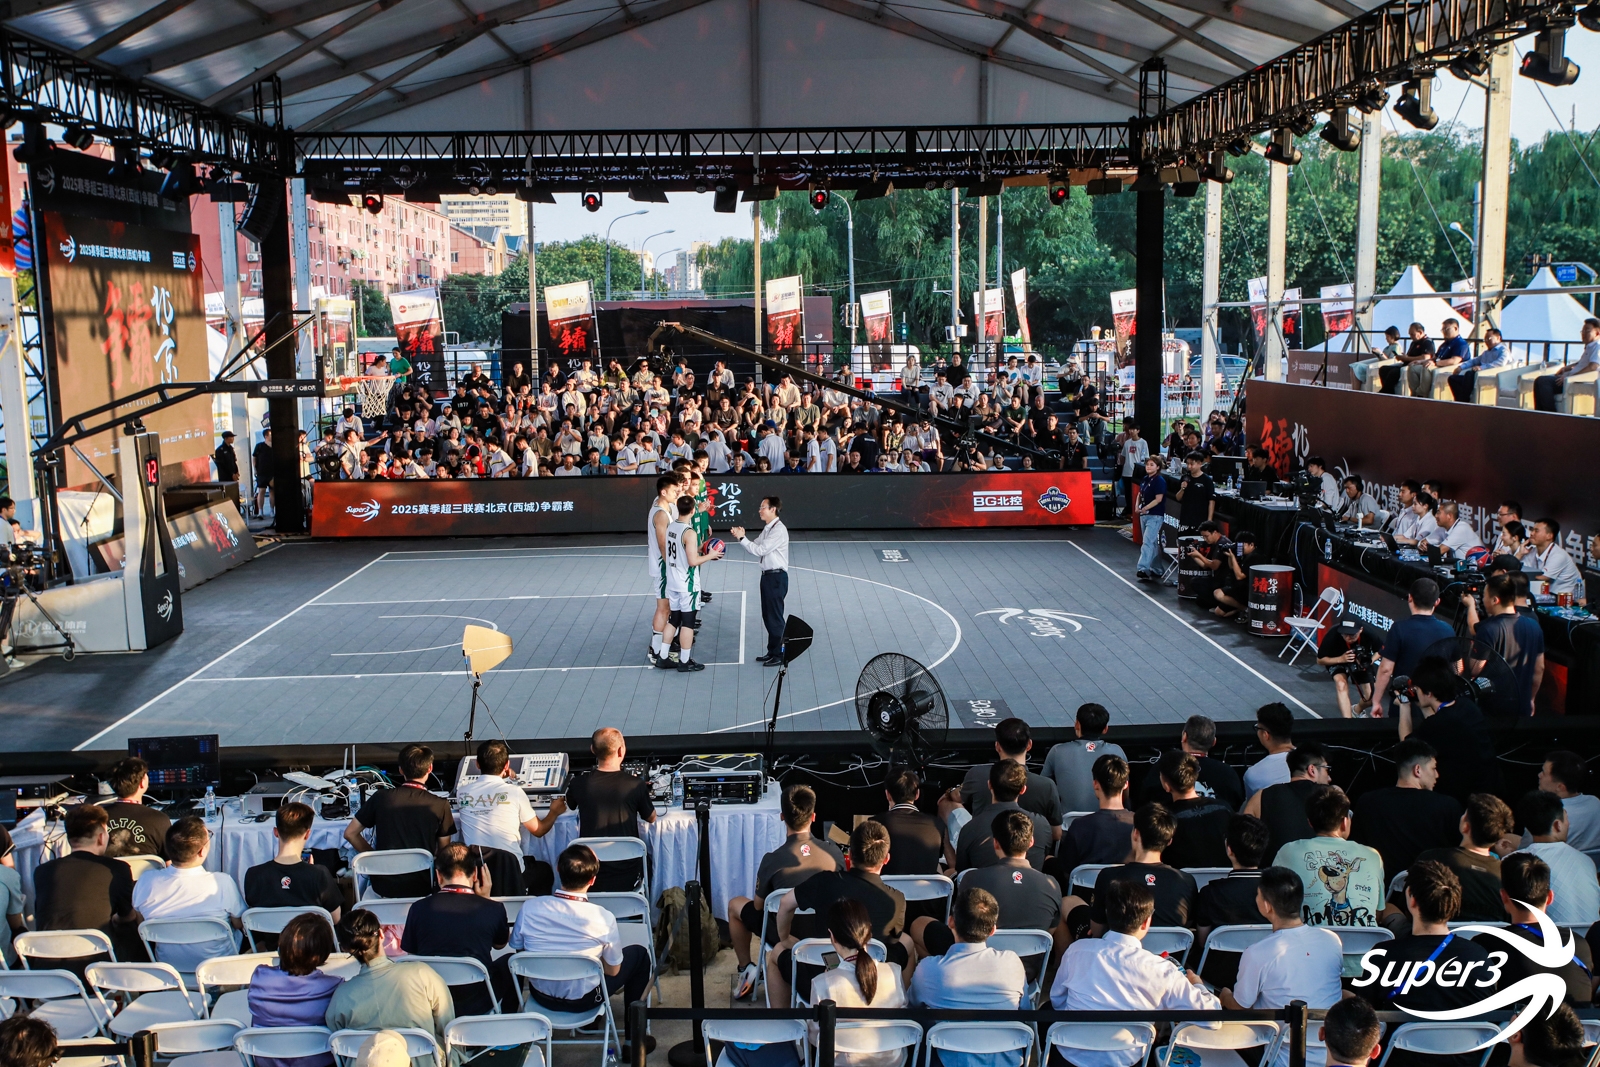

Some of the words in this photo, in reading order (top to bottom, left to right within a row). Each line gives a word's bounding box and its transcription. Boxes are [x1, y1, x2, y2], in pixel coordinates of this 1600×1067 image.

[716, 482, 742, 517] 北京
[973, 496, 1023, 507] BG北控
[345, 504, 370, 515] Super3
[391, 500, 574, 515] 2025赛季超三联赛北京(西城)争霸赛
